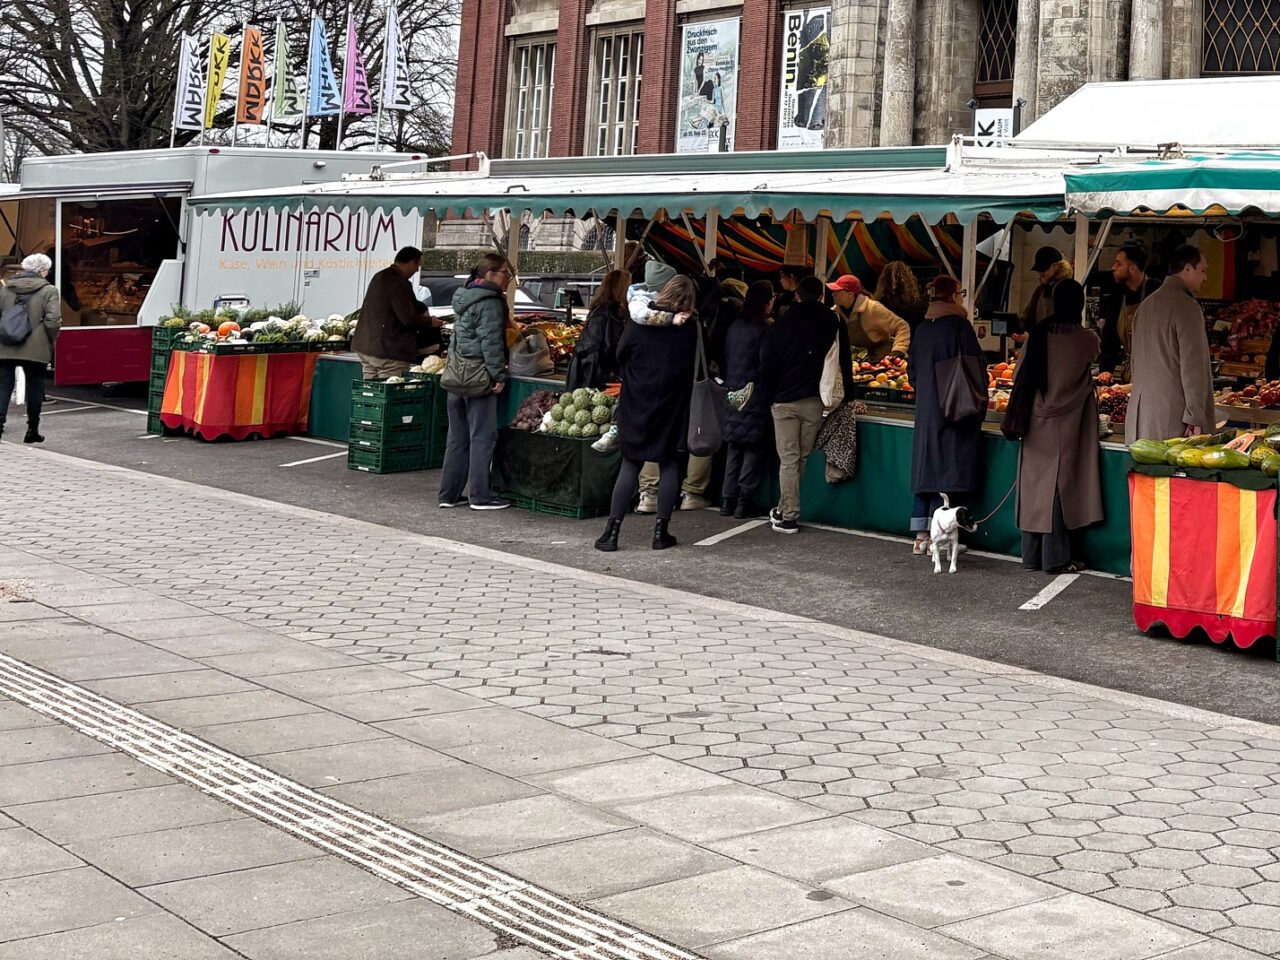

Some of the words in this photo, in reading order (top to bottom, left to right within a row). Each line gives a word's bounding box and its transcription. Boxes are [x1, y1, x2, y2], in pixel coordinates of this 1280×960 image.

[785, 14, 802, 91] Benin.
[220, 211, 397, 252] KULINARIUM
[256, 258, 287, 269] Wein
